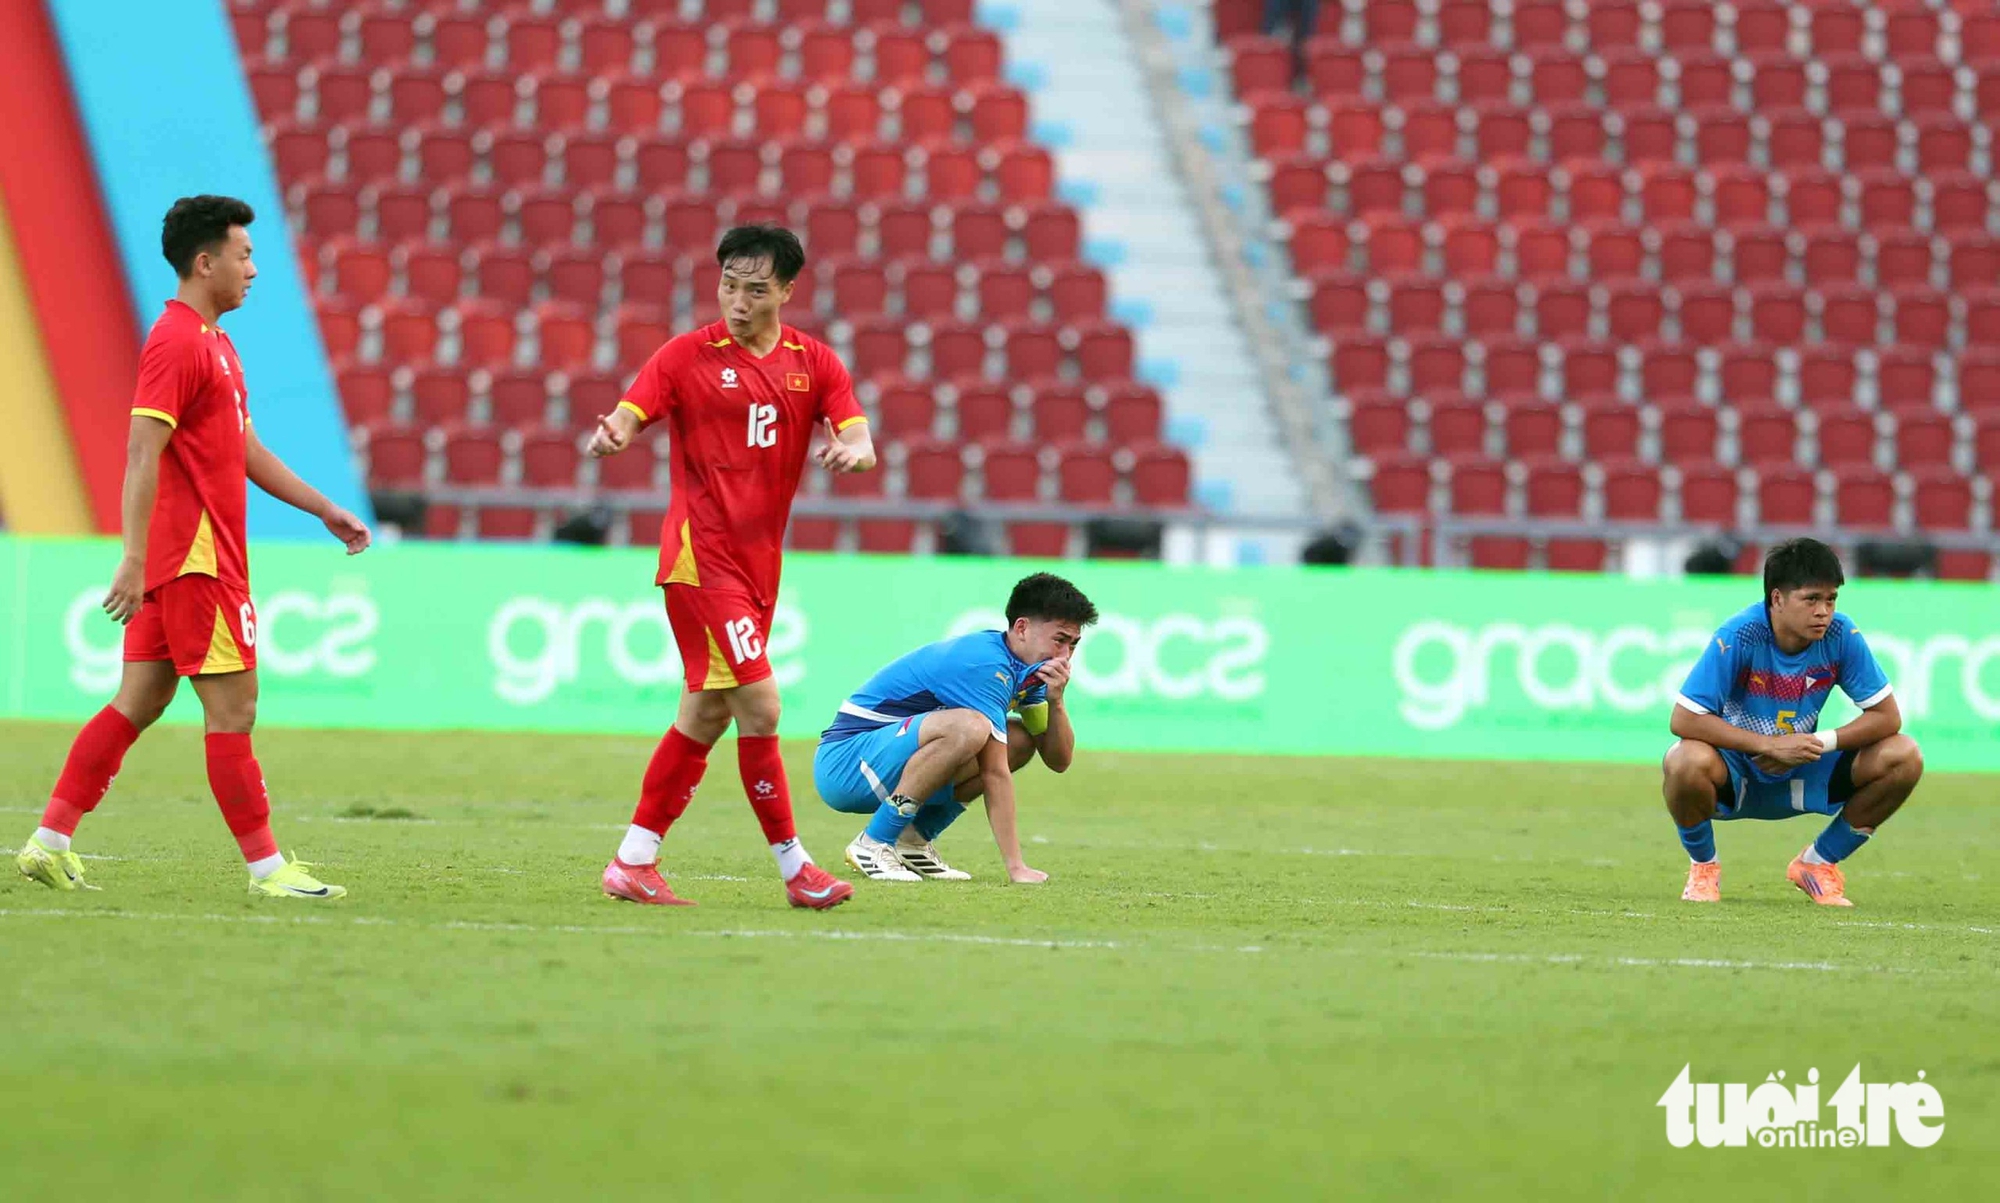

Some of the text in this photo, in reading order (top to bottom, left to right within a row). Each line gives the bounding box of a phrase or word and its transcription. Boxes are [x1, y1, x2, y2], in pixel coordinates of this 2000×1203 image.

[747, 403, 777, 448] 12
[238, 601, 256, 648] 6
[725, 615, 764, 665] 12
[1776, 710, 1796, 735] 5
